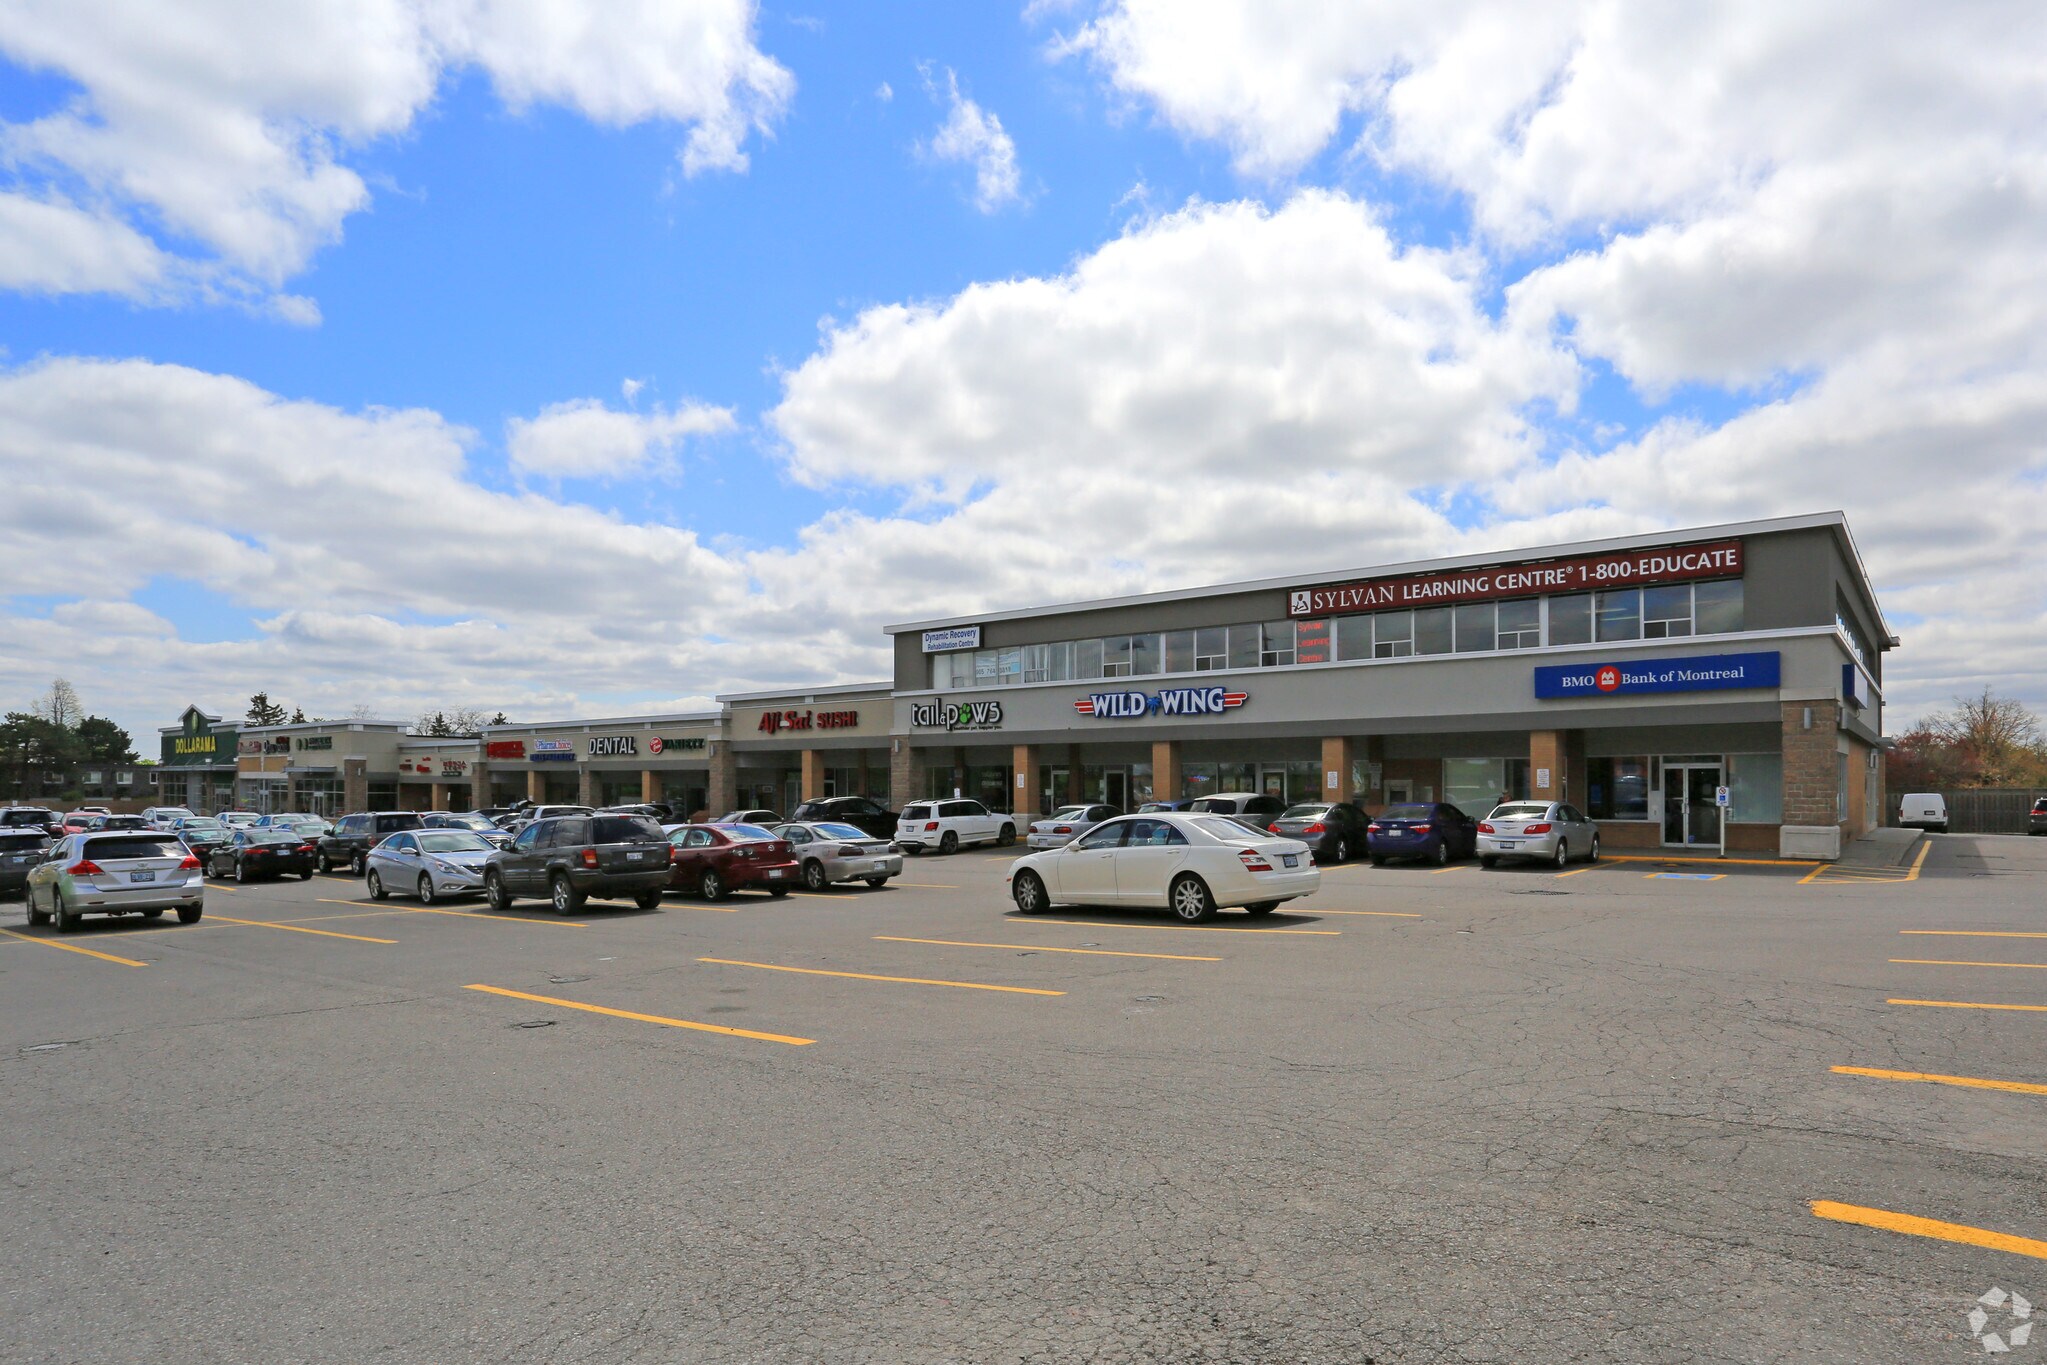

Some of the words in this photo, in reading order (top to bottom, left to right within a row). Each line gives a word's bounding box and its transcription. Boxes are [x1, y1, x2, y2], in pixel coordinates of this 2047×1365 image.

[1314, 585, 1395, 609] SYLVAN
[1403, 576, 1489, 600] LEARNING
[1579, 549, 1737, 581] 1-800-EDUCATE
[925, 631, 949, 643] Dynamic
[949, 629, 977, 639] Recovery
[927, 641, 958, 651] Rehabilitation
[958, 640, 975, 648] Centre
[1562, 675, 1595, 688] BMO
[1622, 671, 1657, 684] Bank
[1659, 670, 1675, 682] of
[1678, 666, 1744, 681] Montreal
[1091, 692, 1146, 717] WILD
[1160, 688, 1224, 714] WING
[816, 711, 858, 728] SUSHI
[175, 736, 216, 754] DOLLARAMA
[588, 737, 635, 754] DENTAL
[662, 738, 705, 750] VARIETY
